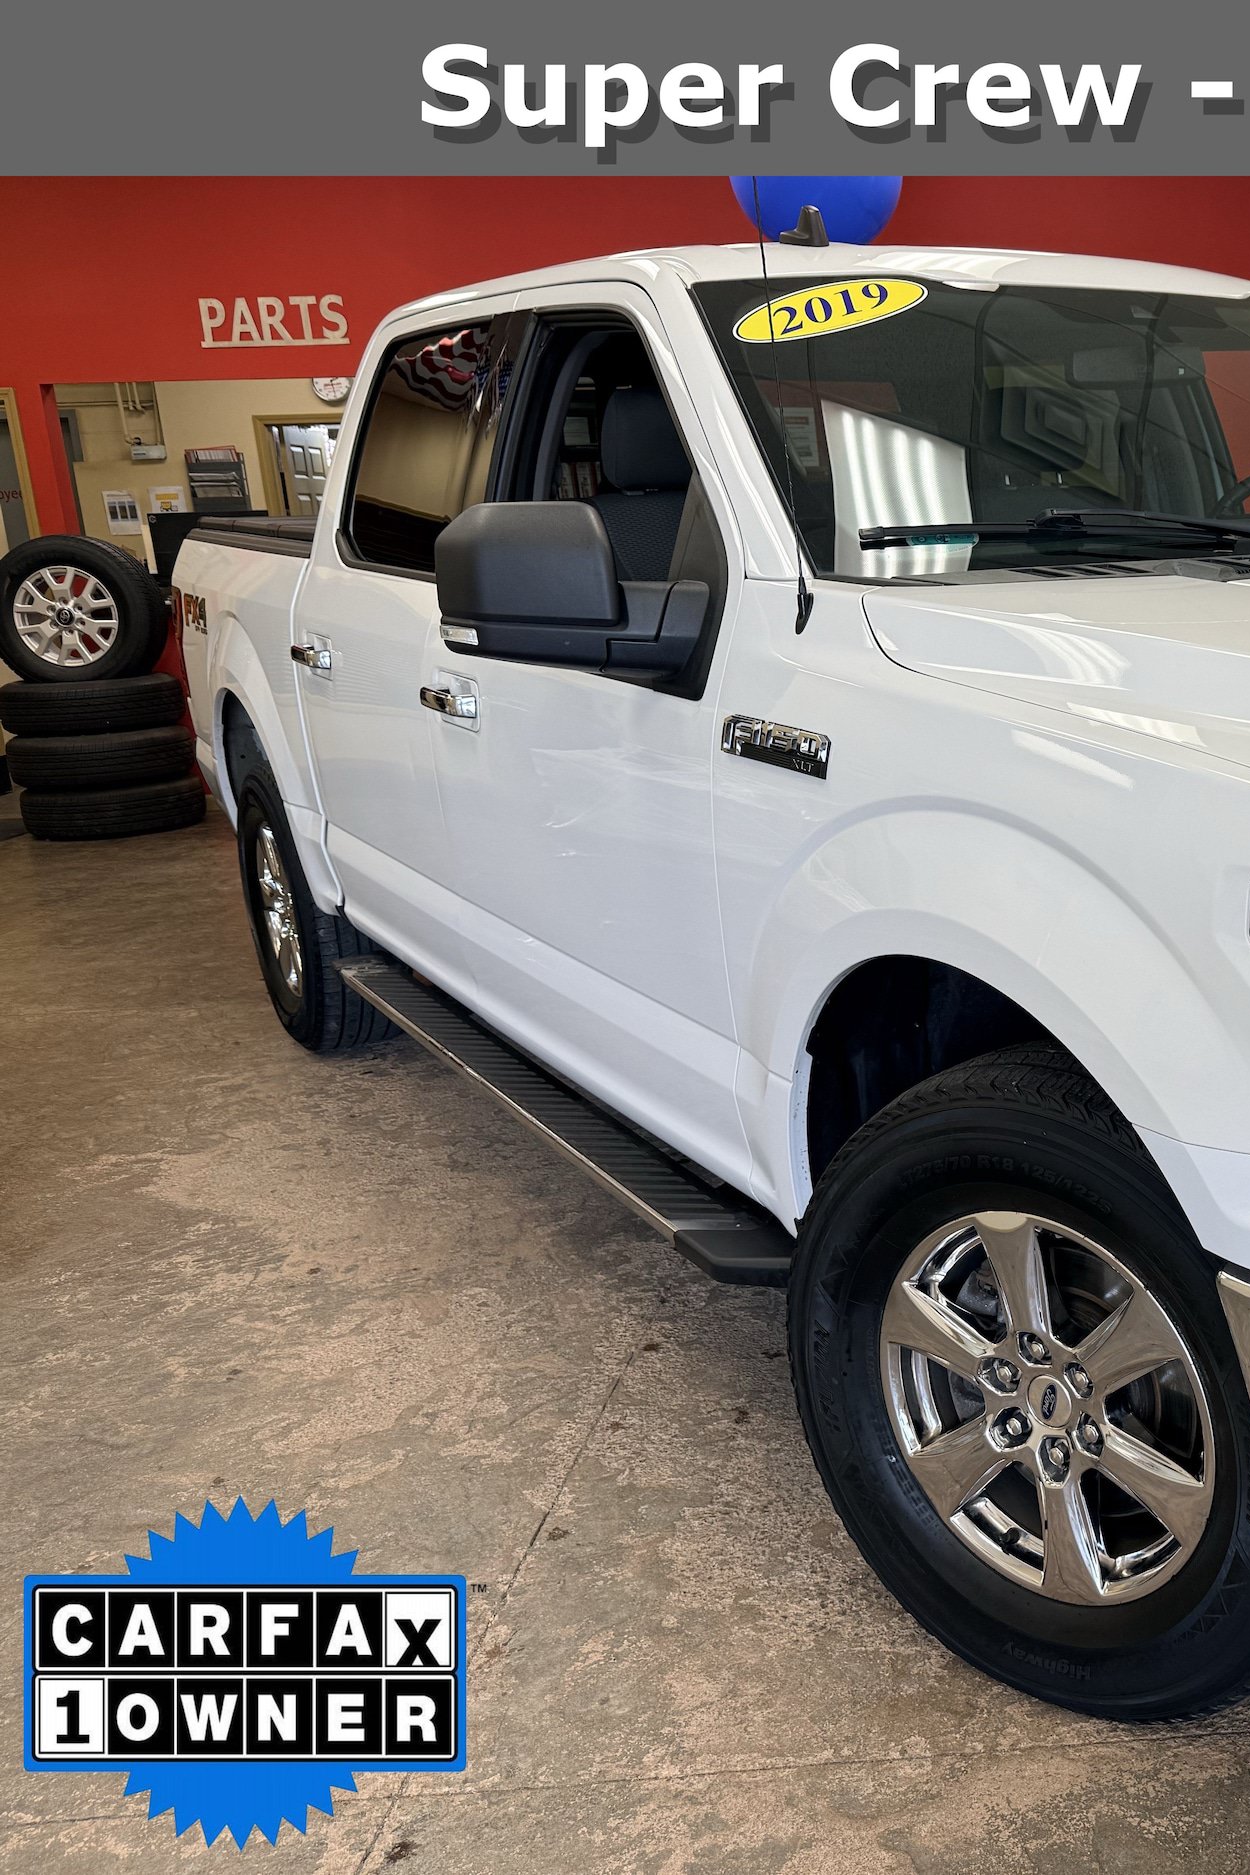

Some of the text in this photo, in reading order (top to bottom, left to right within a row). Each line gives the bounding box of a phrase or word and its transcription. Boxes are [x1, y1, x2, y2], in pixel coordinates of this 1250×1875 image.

[198, 294, 349, 345] PARTS
[773, 283, 888, 335] 2019
[184, 592, 207, 629] FX4
[792, 758, 815, 773] XLT
[1042, 1388, 1056, 1416] Ford
[1002, 1640, 1093, 1681] Highway
